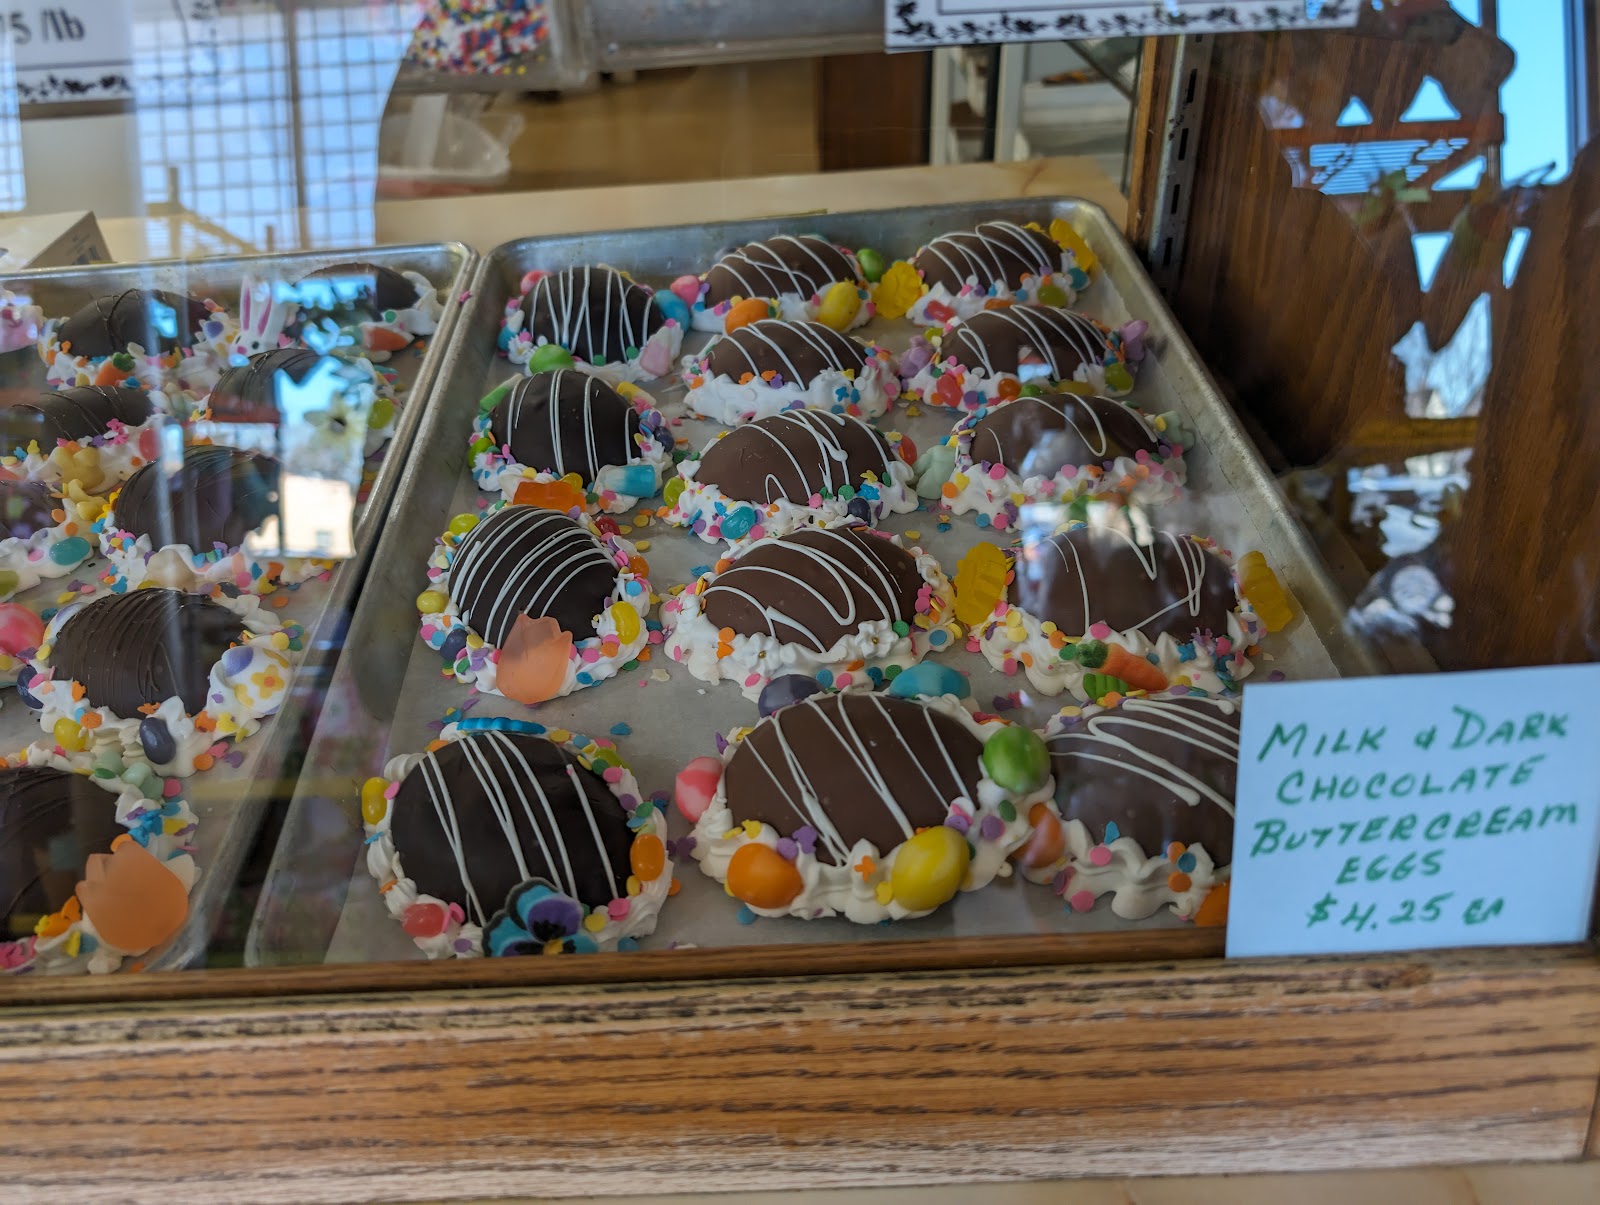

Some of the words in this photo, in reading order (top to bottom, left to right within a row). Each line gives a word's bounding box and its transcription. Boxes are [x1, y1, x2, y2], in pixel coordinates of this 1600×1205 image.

[1257, 722, 1386, 762] MILK
[1451, 704, 1568, 750] DARK
[1276, 754, 1546, 805] CHOCOLATE
[1250, 803, 1578, 857] BUTTERCREAM
[1335, 850, 1444, 884] EGGS
[1306, 892, 1454, 932] $4.25
